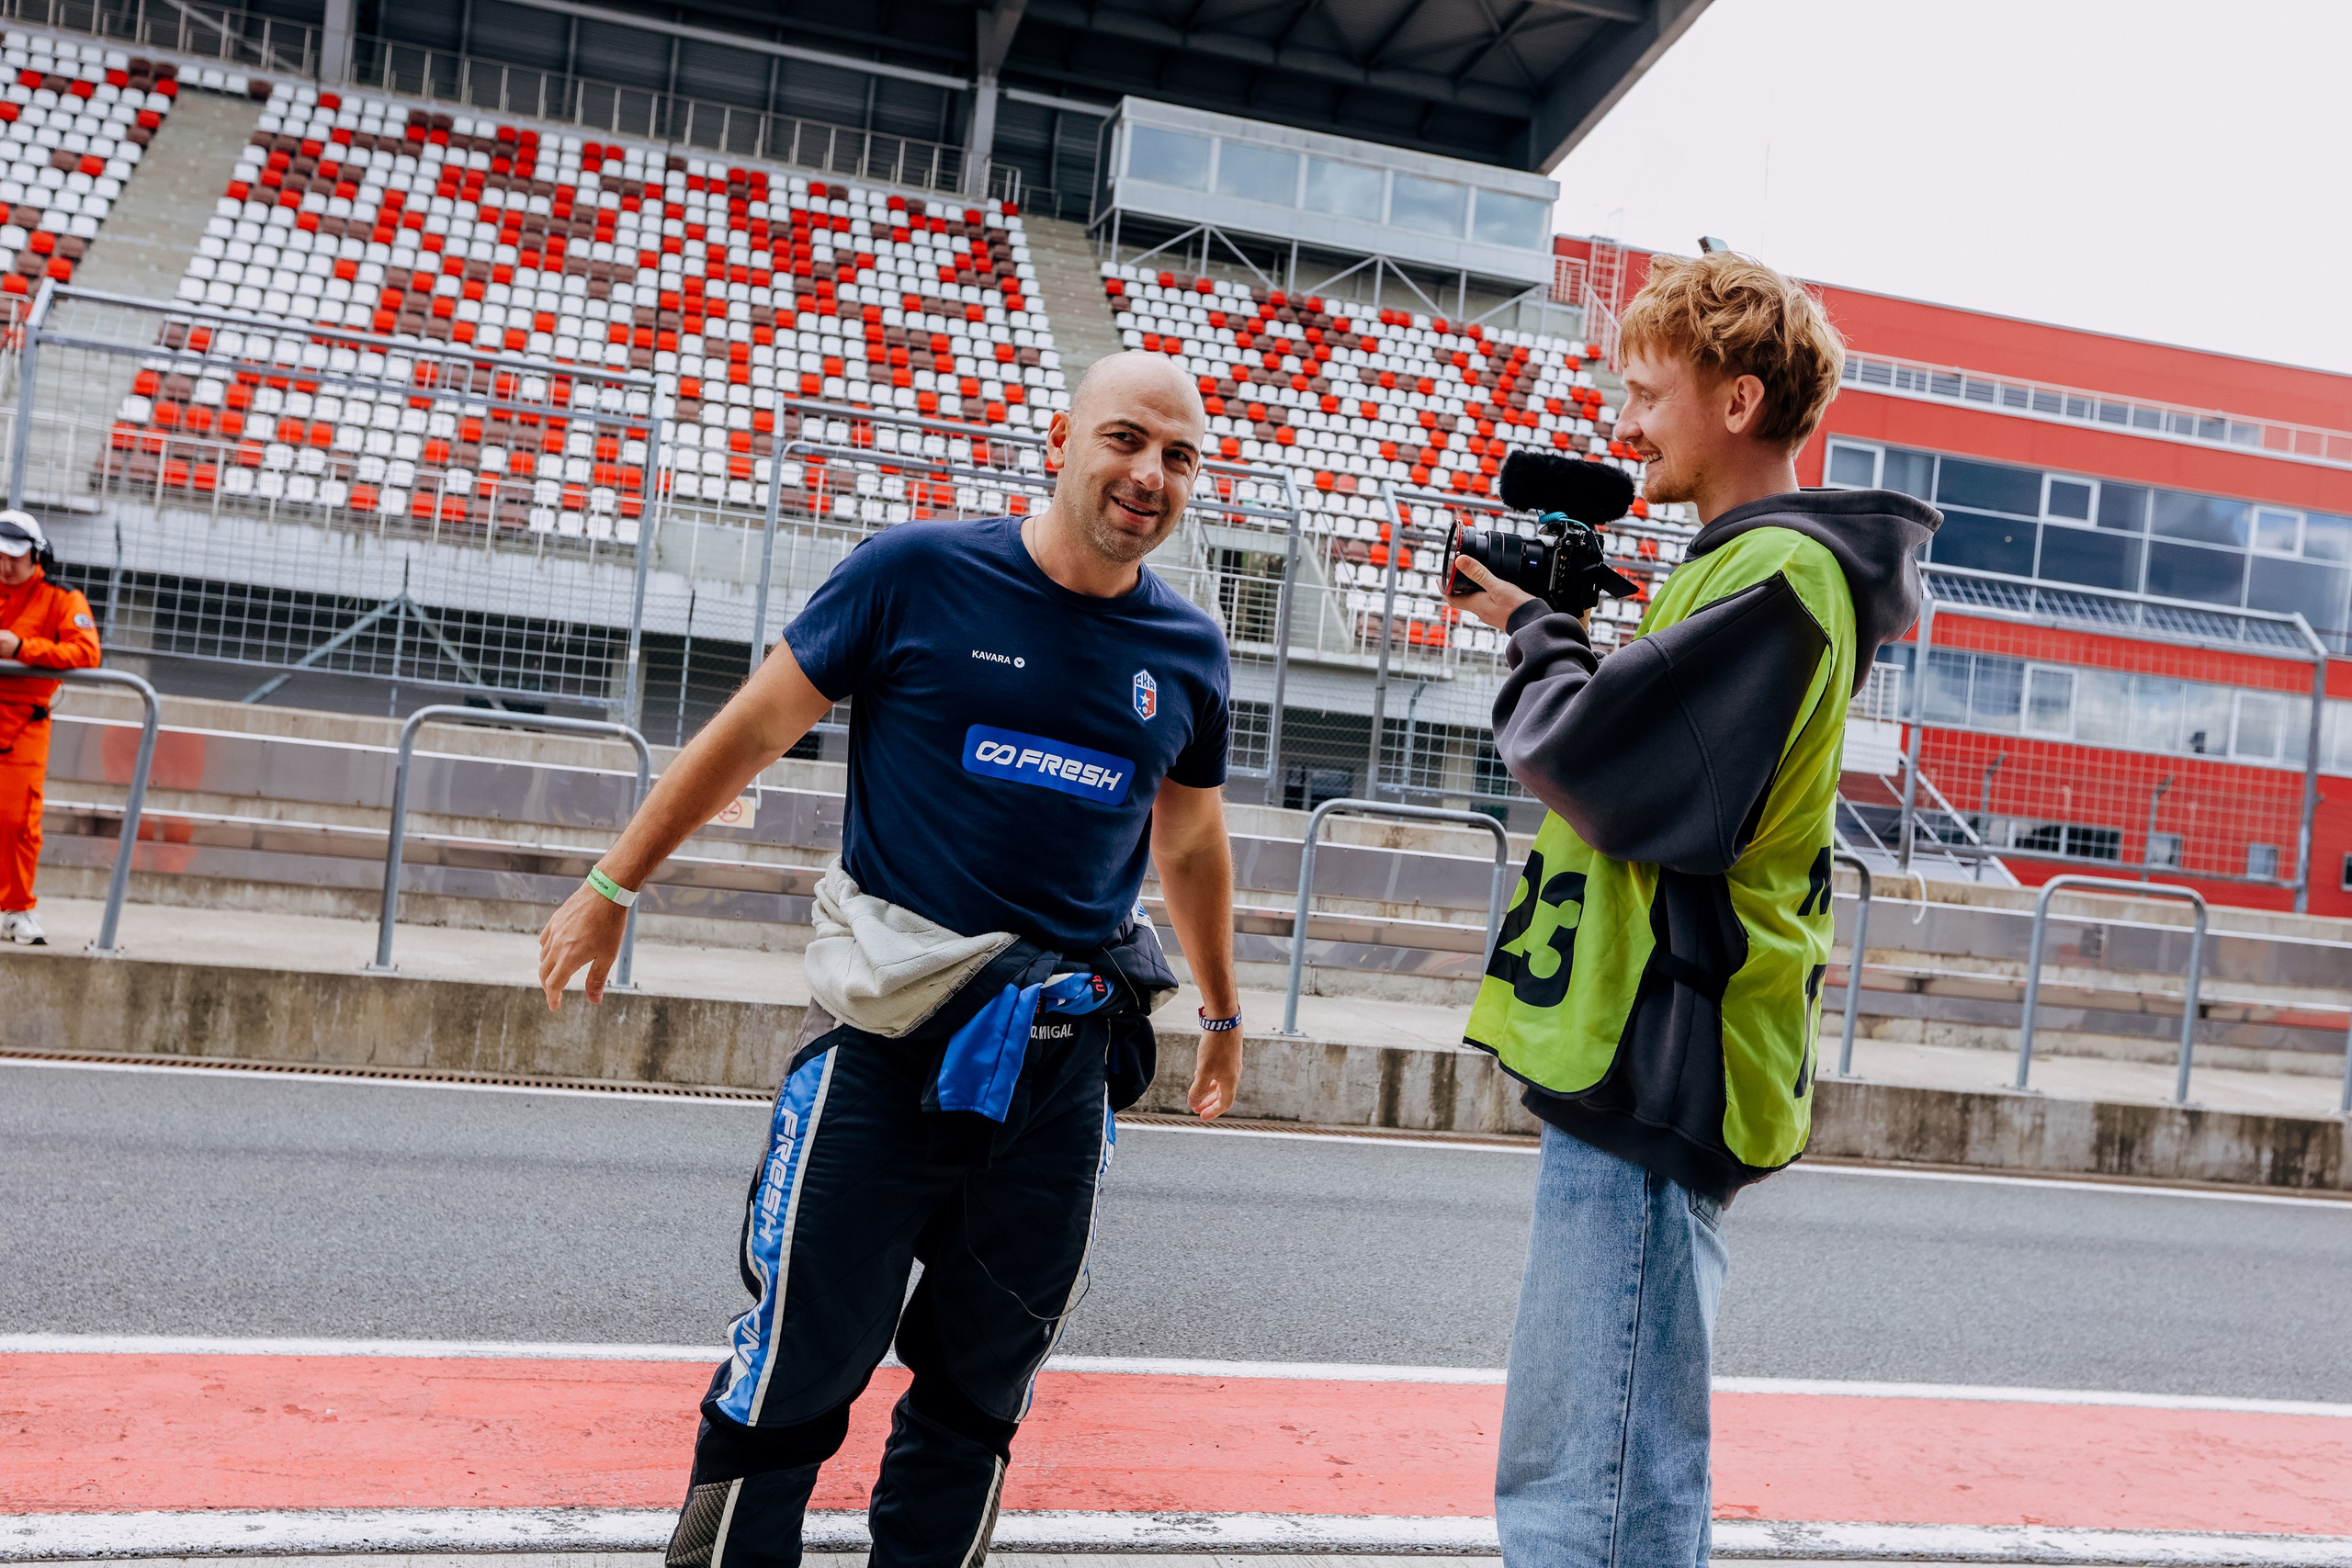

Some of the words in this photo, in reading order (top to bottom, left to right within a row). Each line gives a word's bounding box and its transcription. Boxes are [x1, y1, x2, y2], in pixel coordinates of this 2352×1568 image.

[972, 649, 1011, 665] KAVARA
[1486, 850, 1588, 1008] 23
[759, 1107, 798, 1243] FRESH
